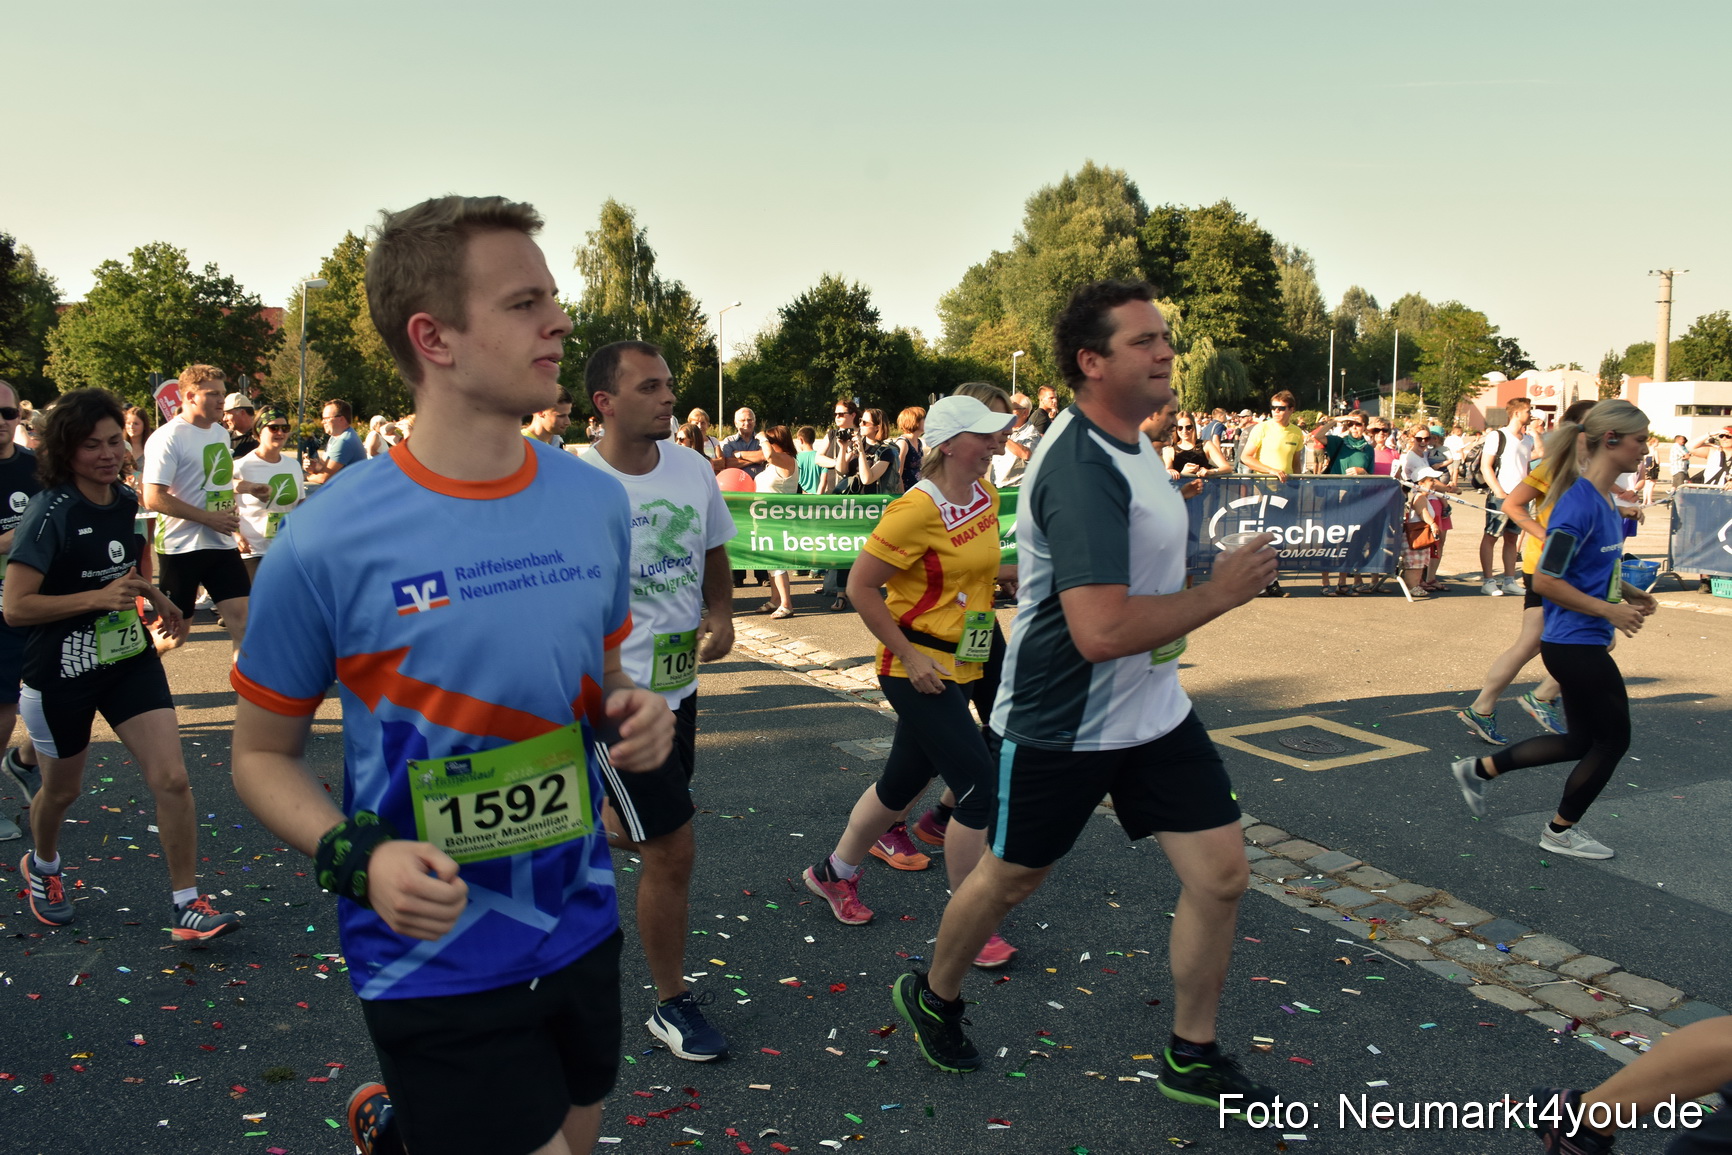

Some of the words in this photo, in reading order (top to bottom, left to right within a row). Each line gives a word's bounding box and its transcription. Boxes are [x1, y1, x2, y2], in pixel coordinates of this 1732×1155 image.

[214, 500, 236, 512] 156
[750, 499, 887, 520] Gesundhei
[630, 516, 650, 529] ATA
[1238, 519, 1361, 545] Fischer
[750, 531, 774, 552] in
[782, 530, 867, 552] besten
[950, 526, 978, 547] MAX
[1000, 540, 1016, 550] Die
[1275, 547, 1349, 559] TOMOBILE
[453, 549, 565, 582] Raiffeisenbank
[640, 551, 693, 579] Laufend
[459, 573, 539, 601] Neumarkt
[586, 565, 602, 580] eG
[117, 623, 138, 646] 75
[438, 773, 569, 835] 1592
[444, 830, 499, 849] Böhmer
[500, 813, 570, 840] Maximilian
